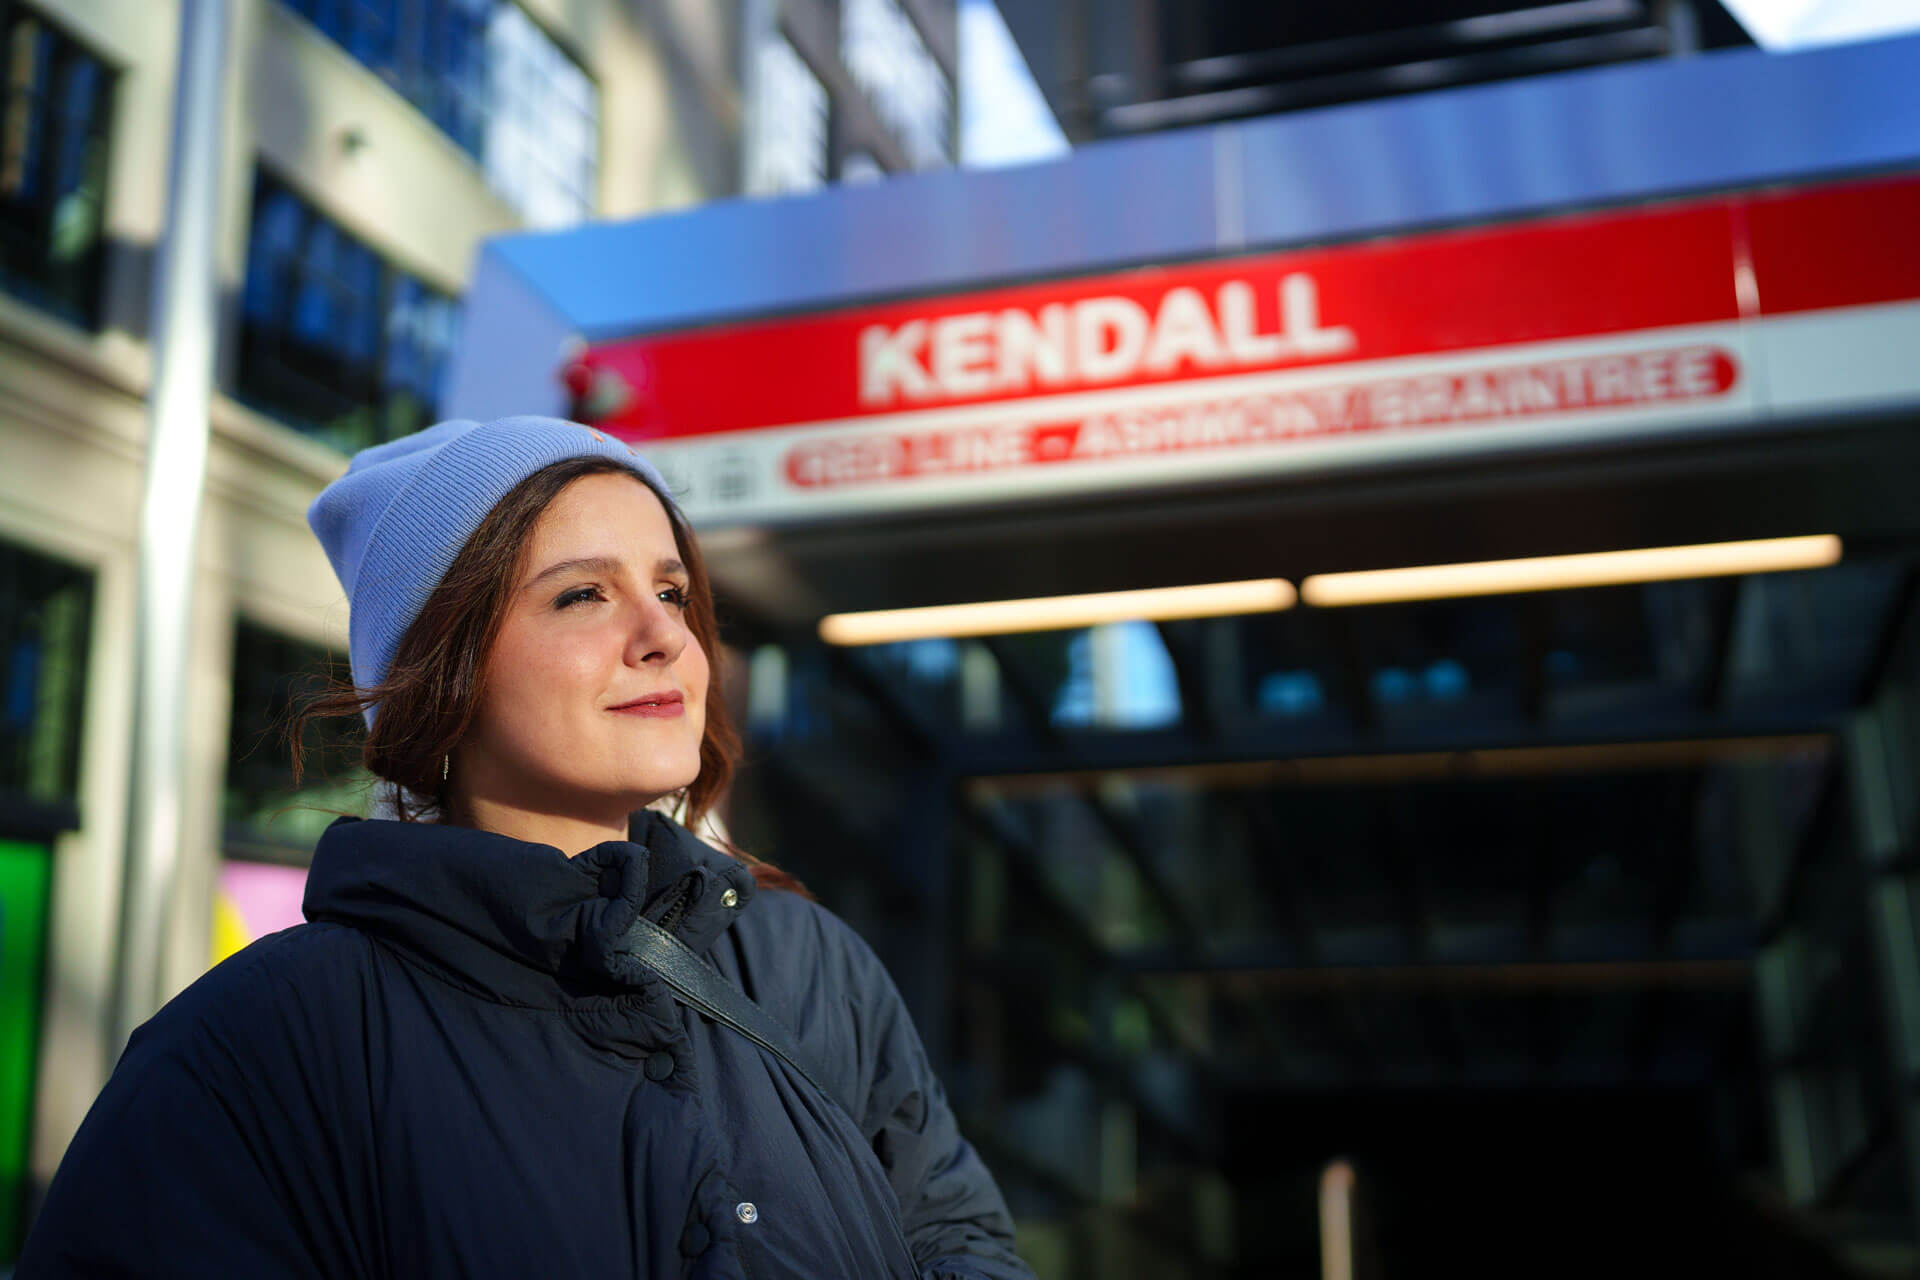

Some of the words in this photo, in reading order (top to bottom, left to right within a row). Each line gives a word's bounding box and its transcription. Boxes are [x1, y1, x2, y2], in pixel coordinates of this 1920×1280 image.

[859, 274, 1355, 405] KENDALL
[796, 435, 900, 484] RED
[908, 422, 1032, 474] LINE
